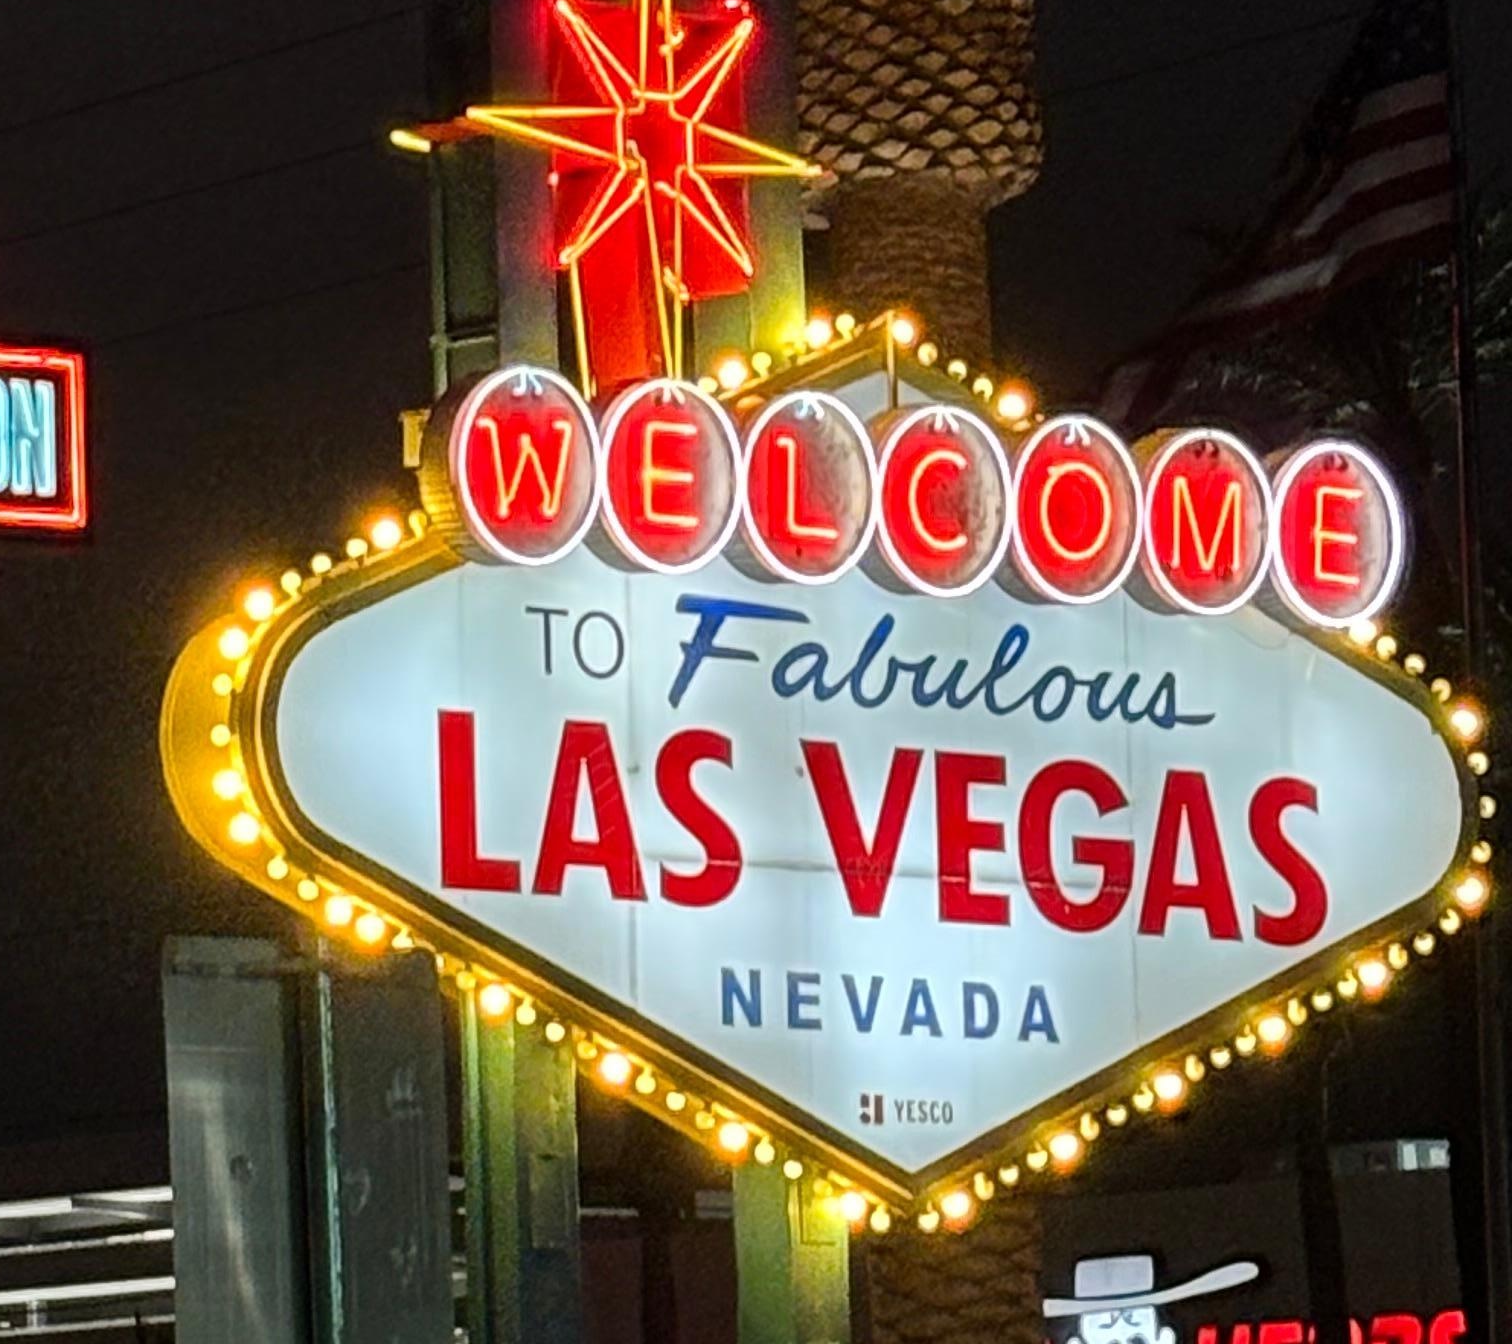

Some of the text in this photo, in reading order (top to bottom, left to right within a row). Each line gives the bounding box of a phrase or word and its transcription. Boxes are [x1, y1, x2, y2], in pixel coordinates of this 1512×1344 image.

[474, 414, 1369, 588] WELCOME
[524, 593, 1216, 729] TO Fabulous
[436, 707, 1330, 947] LAS VEGAS
[719, 966, 1062, 1045] NEVADA
[893, 1098, 954, 1125] YESCO
